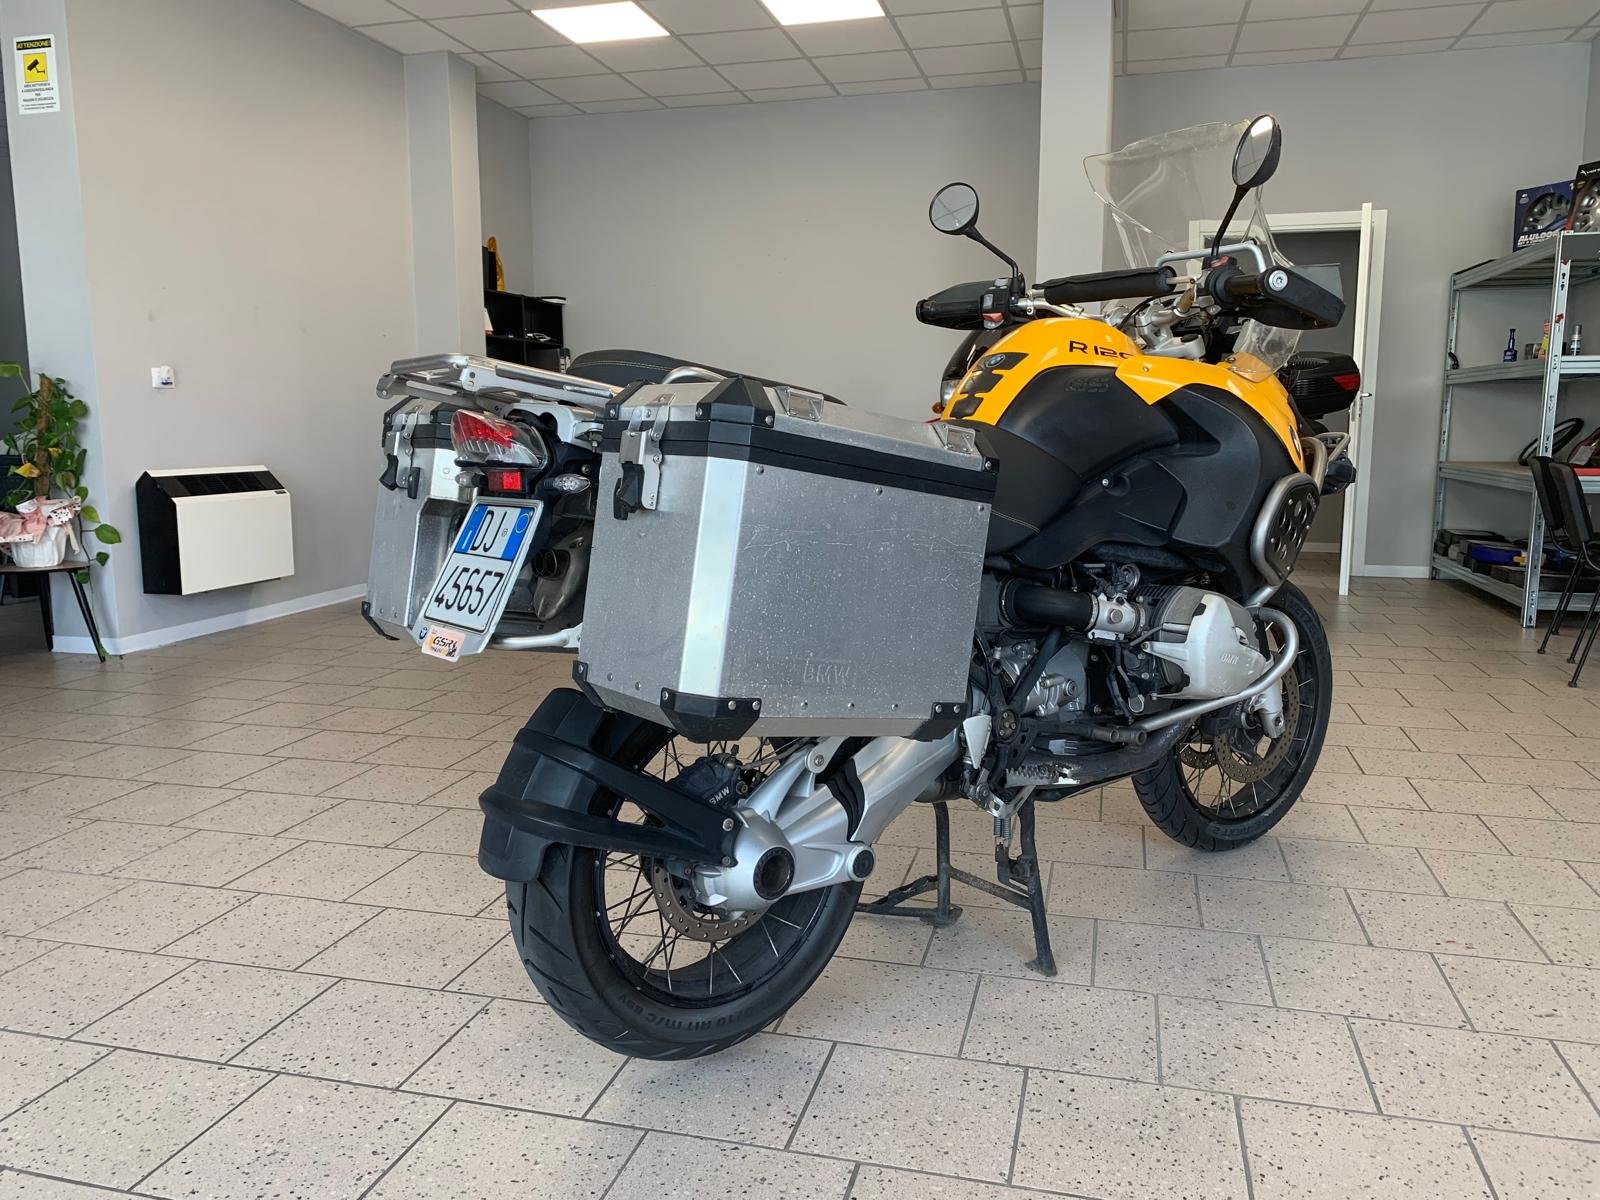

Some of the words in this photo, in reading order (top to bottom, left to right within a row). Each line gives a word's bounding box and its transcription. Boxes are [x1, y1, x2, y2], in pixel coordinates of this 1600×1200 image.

[1069, 340, 1088, 354] R
[471, 510, 507, 552] DJ
[434, 566, 505, 616] 45657
[709, 786, 730, 804] BMW
